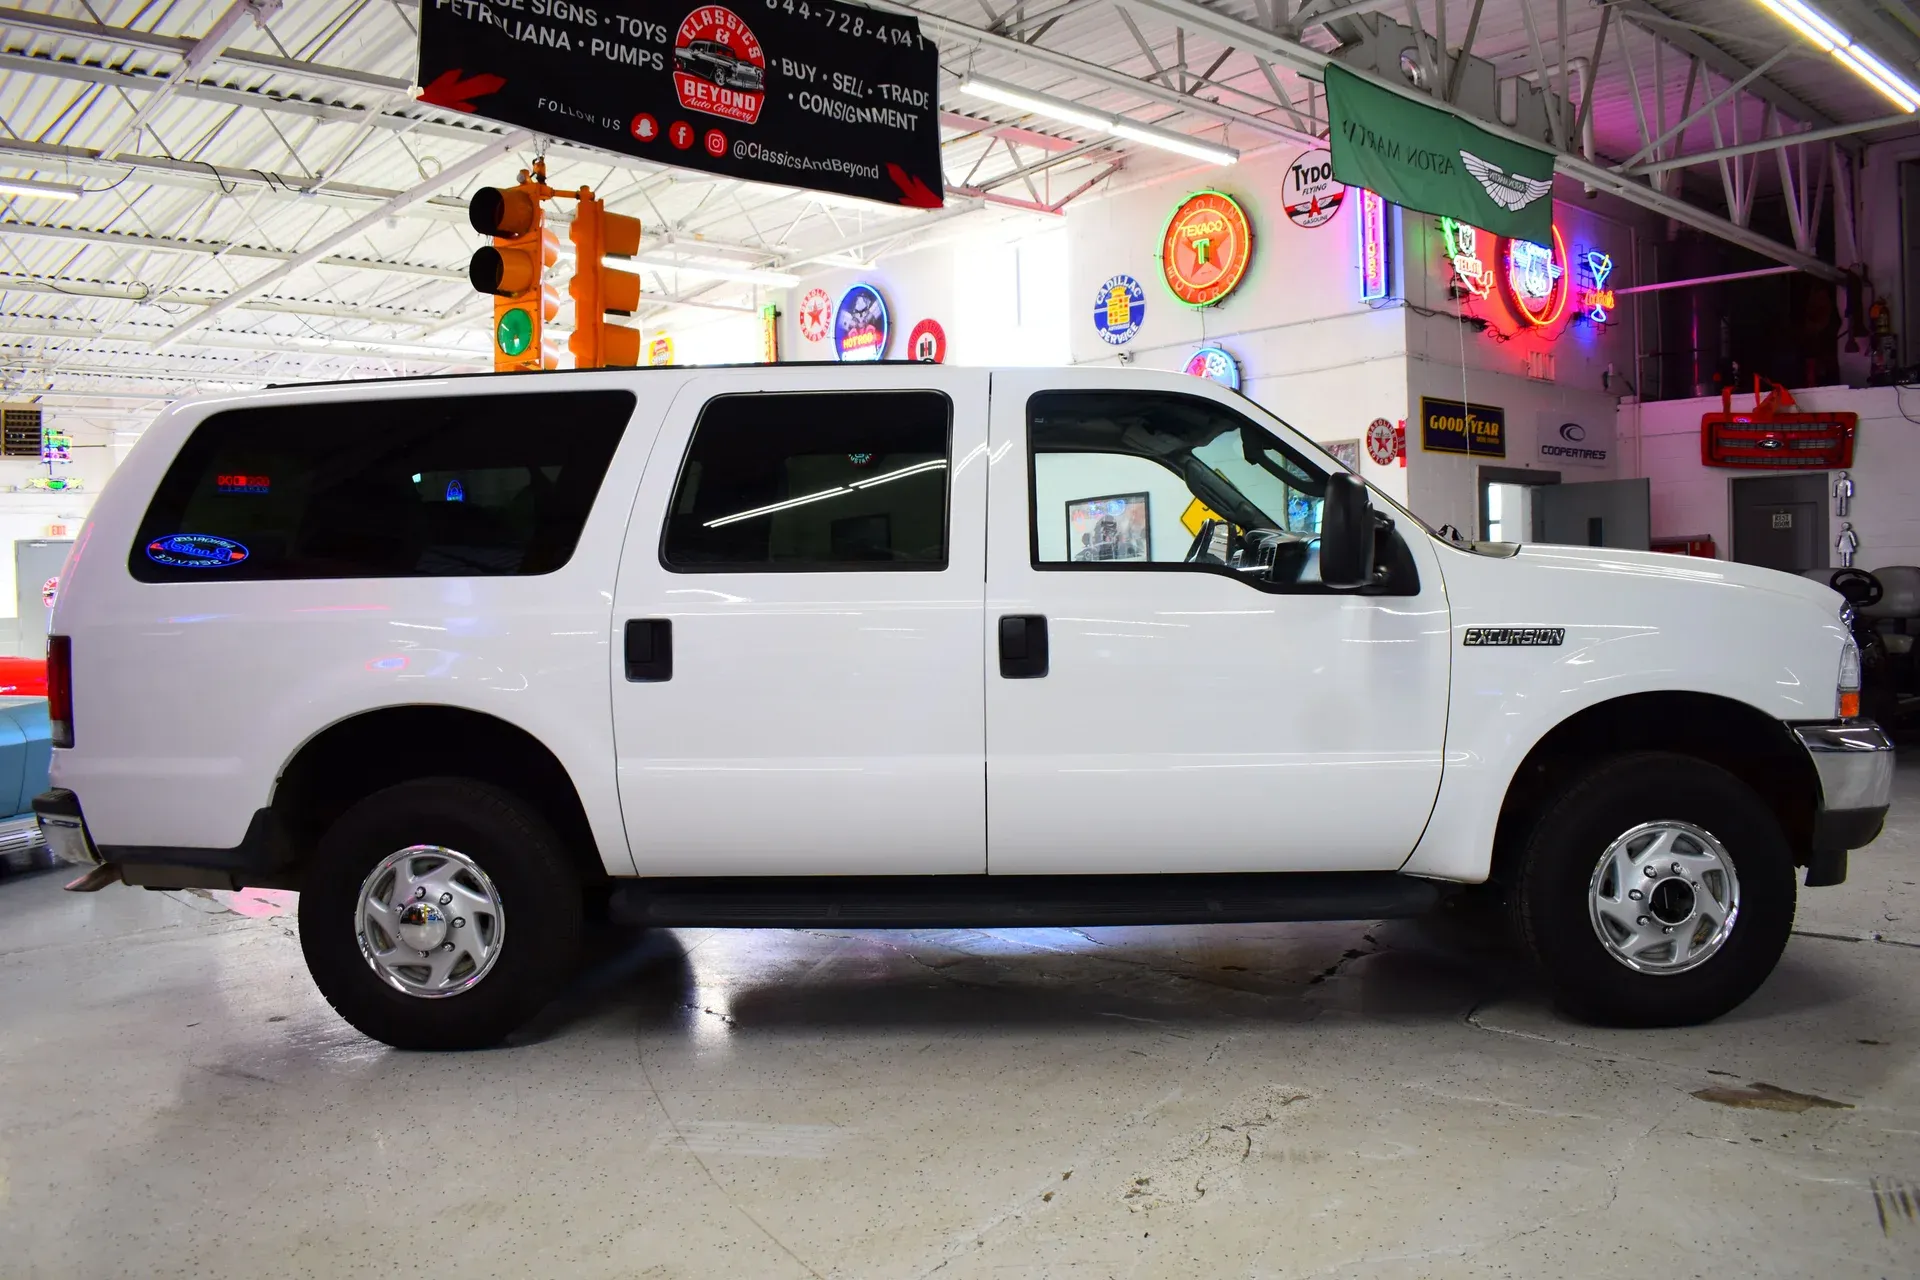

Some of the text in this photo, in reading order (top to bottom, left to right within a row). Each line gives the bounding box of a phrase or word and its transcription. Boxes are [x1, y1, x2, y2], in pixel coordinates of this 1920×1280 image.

[531, 0, 668, 44] SIGNS TOYS
[682, 9, 760, 59] CLASSICS
[715, 28, 730, 45] &
[591, 38, 664, 71] PUMPS
[683, 79, 756, 111] BEYOND
[782, 58, 929, 110] BUY SELL TRADE
[538, 98, 621, 131] FOLLOW US
[685, 97, 753, 122] Auto Gallery
[798, 91, 918, 132] CONSIGNMENT
[733, 139, 879, 180] @ClassicsAndBeyond
[1292, 162, 1332, 191] TYDO
[1302, 183, 1327, 196] FLYING
[1181, 220, 1223, 237] TEXACO
[1303, 214, 1329, 226] GASOLINE
[1096, 275, 1142, 305] CADILLAC
[1167, 264, 1220, 303] MOTOR
[1099, 322, 1139, 344] SERVICE
[1429, 414, 1499, 437] GOODYEAR
[1465, 629, 1566, 645] EXCURSION
